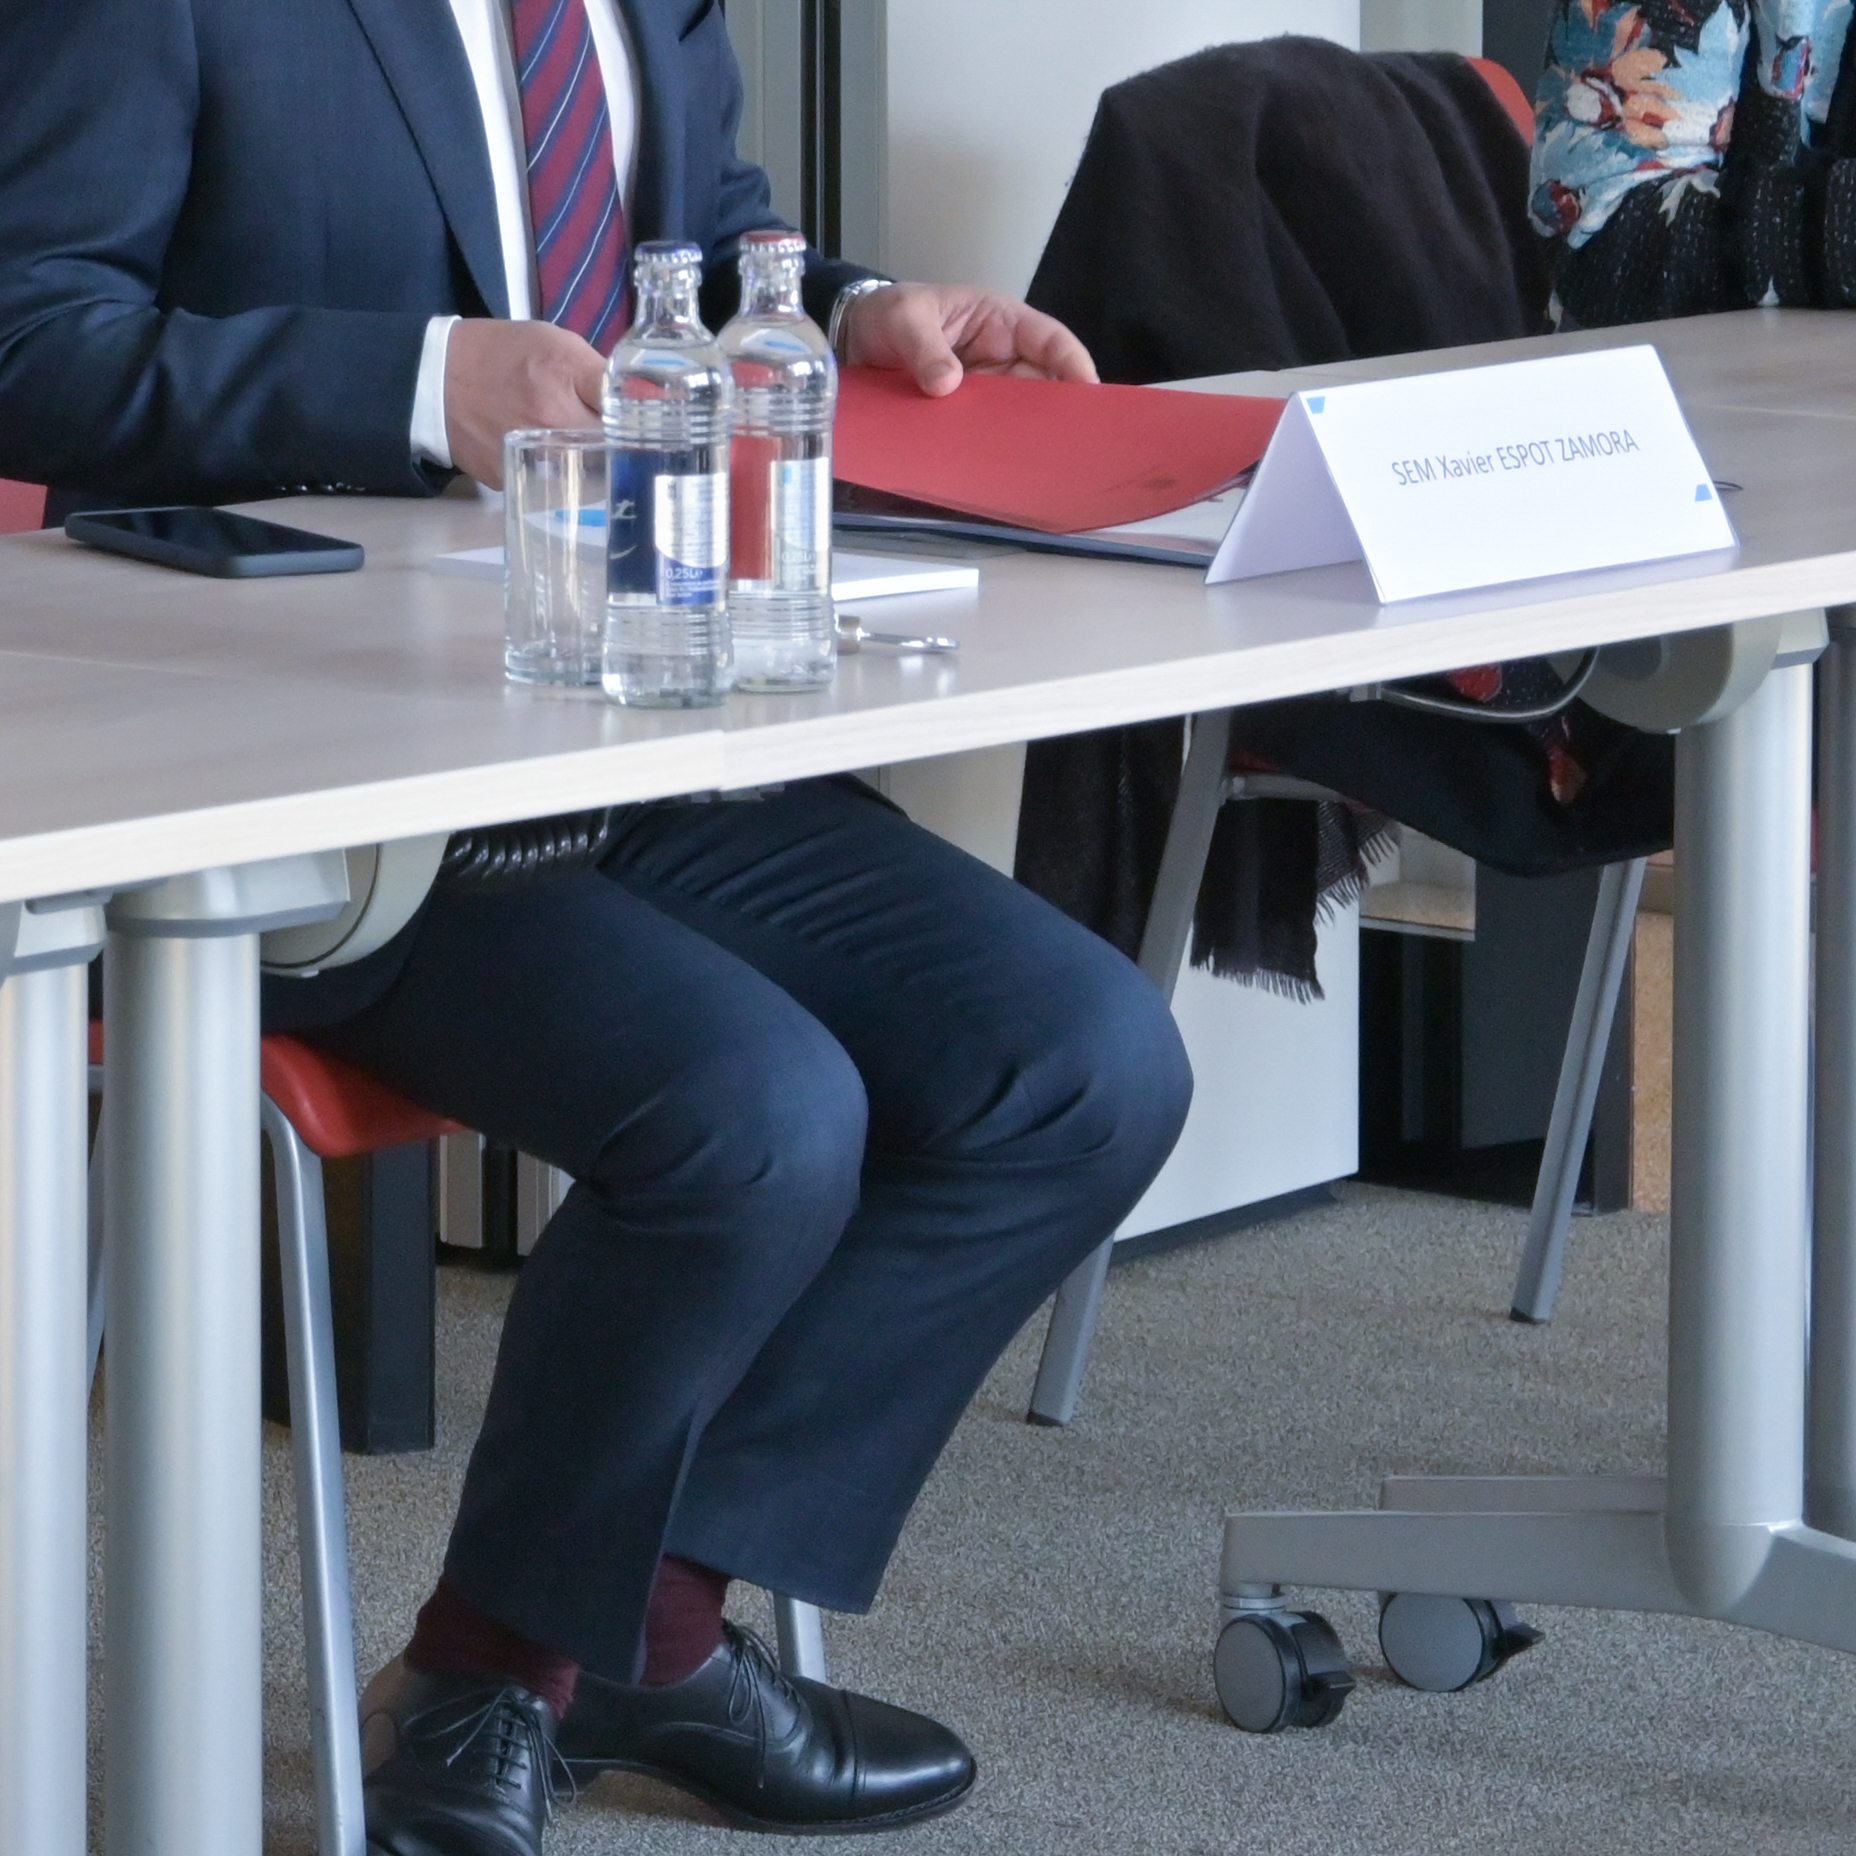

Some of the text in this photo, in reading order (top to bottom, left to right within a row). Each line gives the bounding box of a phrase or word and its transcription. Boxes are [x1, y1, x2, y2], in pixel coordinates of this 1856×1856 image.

[1391, 429, 1641, 486] SEM Xavier ESPOT ZAMORA
